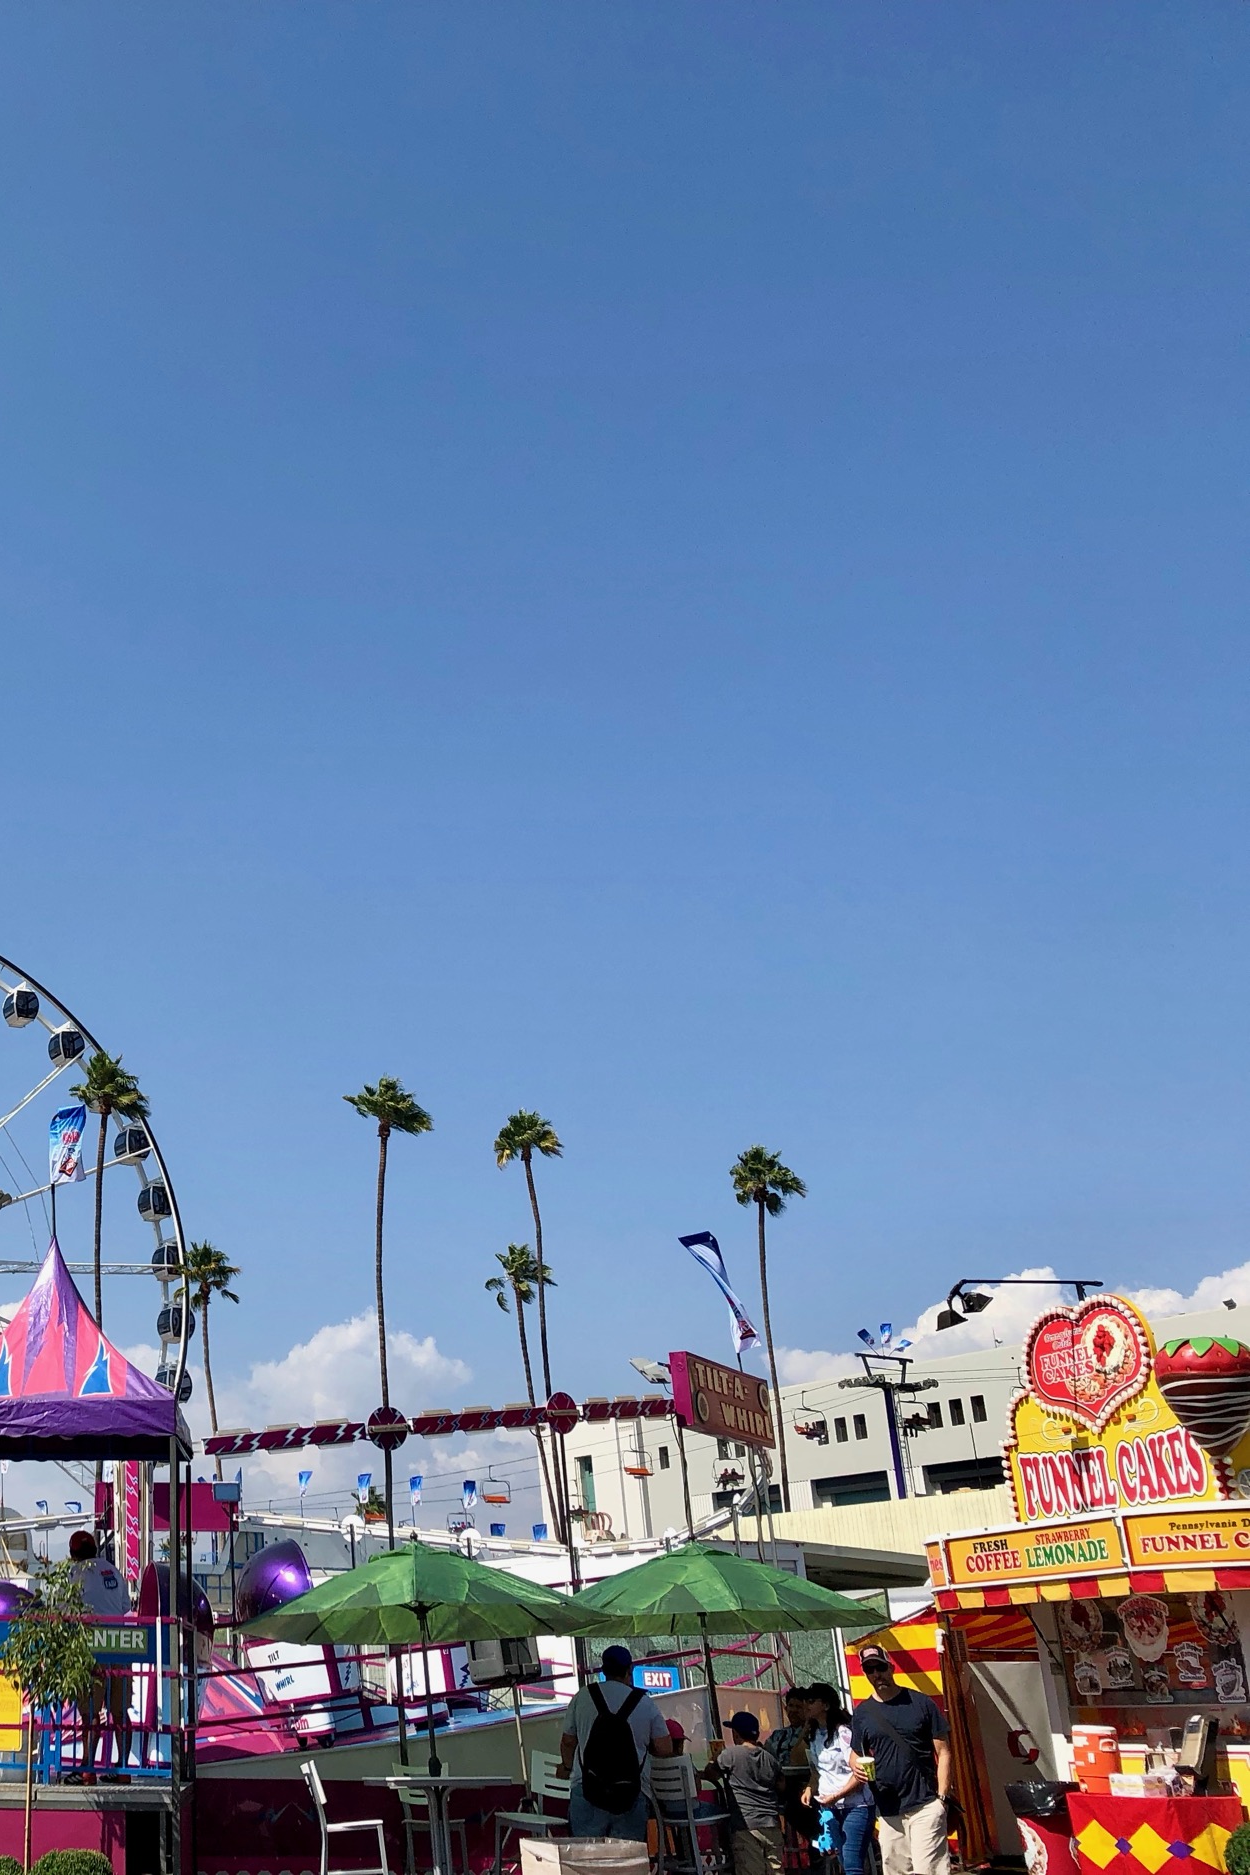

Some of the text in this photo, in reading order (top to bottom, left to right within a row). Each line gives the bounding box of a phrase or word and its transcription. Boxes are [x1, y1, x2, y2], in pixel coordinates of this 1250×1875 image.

[1040, 1346, 1093, 1370] FUNNEL
[1043, 1361, 1095, 1384] CAKES
[720, 1401, 773, 1440] WHIRL
[1018, 1426, 1208, 1518] FUNNEL CAKES
[1168, 1519, 1237, 1531] Pennsylvania
[972, 1539, 1009, 1554] FRESH
[1035, 1528, 1091, 1545] STRAWBERRY
[1140, 1533, 1229, 1554] FUNNEL
[966, 1551, 1022, 1573] COFFEE
[1025, 1539, 1109, 1568] LEMONADE
[268, 1650, 280, 1663] TILT
[275, 1675, 295, 1692] WHIRL
[644, 1672, 671, 1687] EXIT
